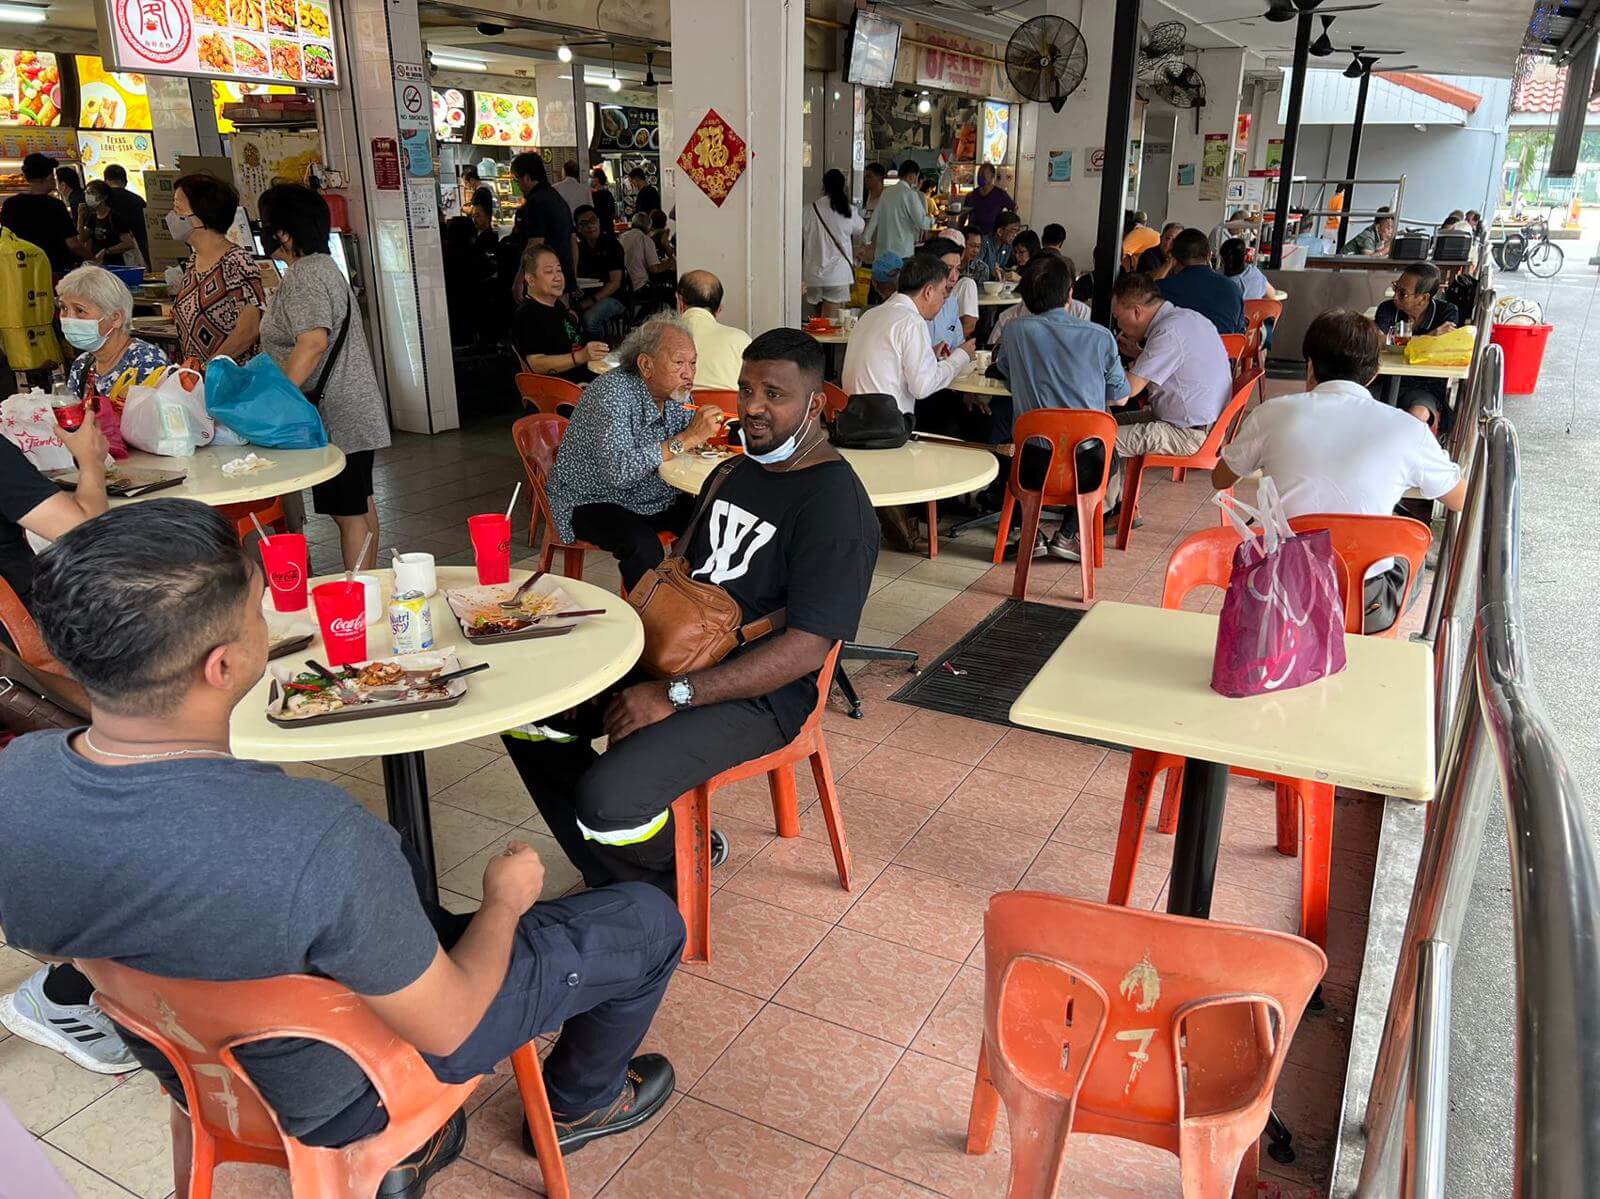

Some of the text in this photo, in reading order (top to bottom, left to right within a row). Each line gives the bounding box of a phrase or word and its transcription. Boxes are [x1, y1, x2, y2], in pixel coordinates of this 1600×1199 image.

[107, 135, 126, 144] TEXAS
[694, 124, 729, 168] 福
[390, 611, 409, 624] Nutri
